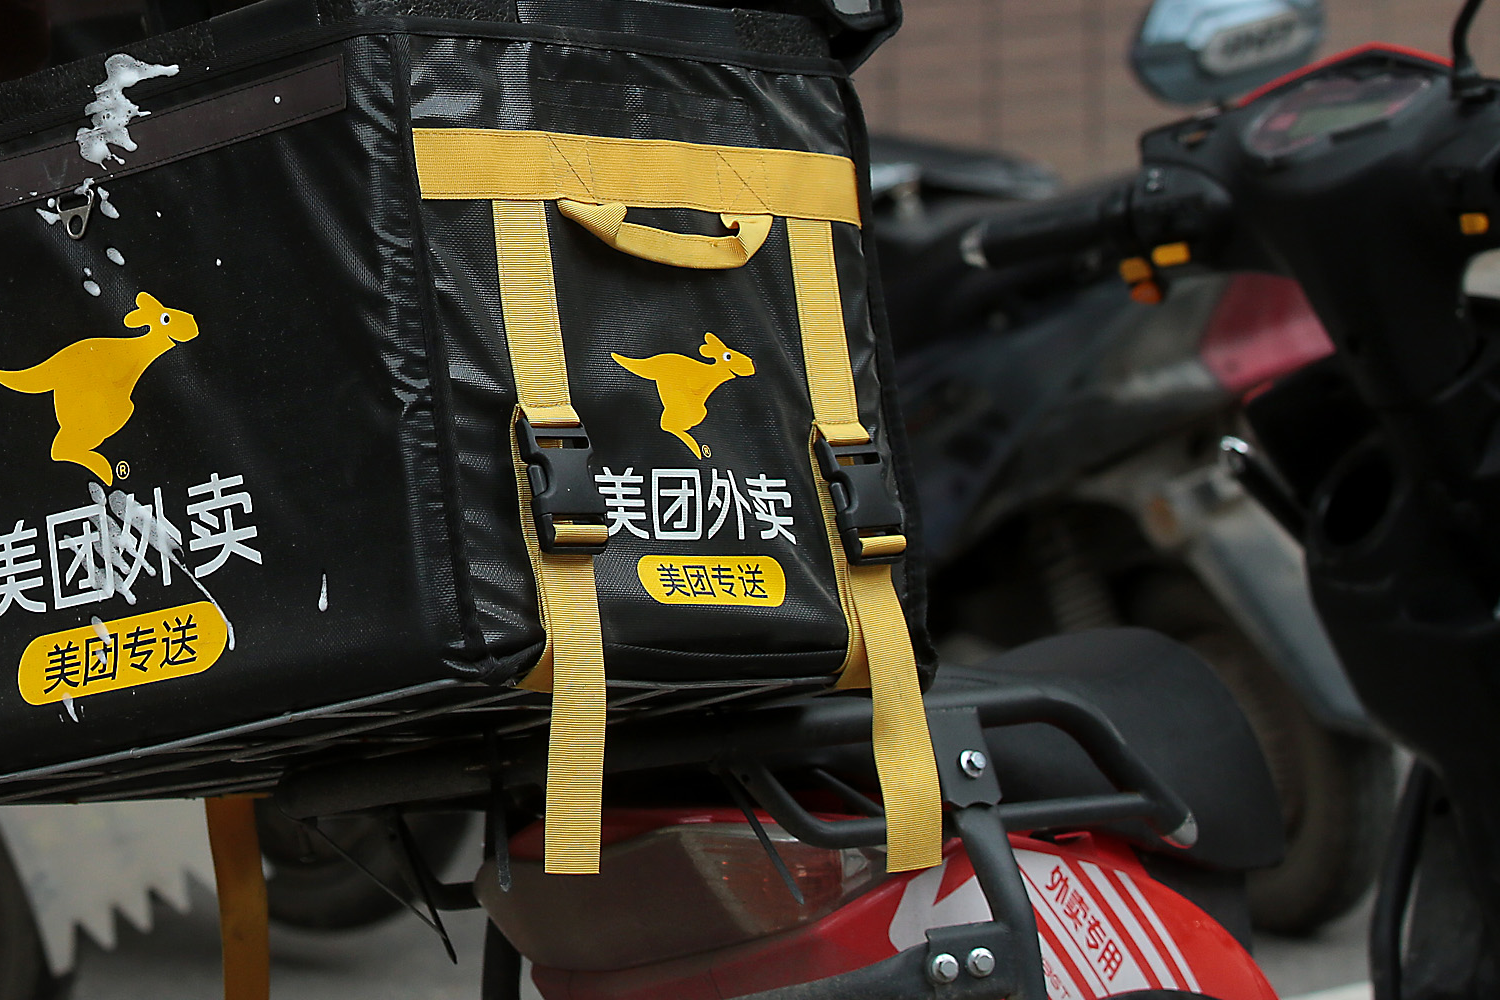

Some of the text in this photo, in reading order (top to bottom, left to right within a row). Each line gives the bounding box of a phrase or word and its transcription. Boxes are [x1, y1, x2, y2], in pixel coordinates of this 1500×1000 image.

[594, 466, 797, 545] 美团外卖
[656, 563, 768, 599] 美团专送
[43, 613, 199, 695] 美团专送
[1045, 865, 1123, 982] 外卖专用
